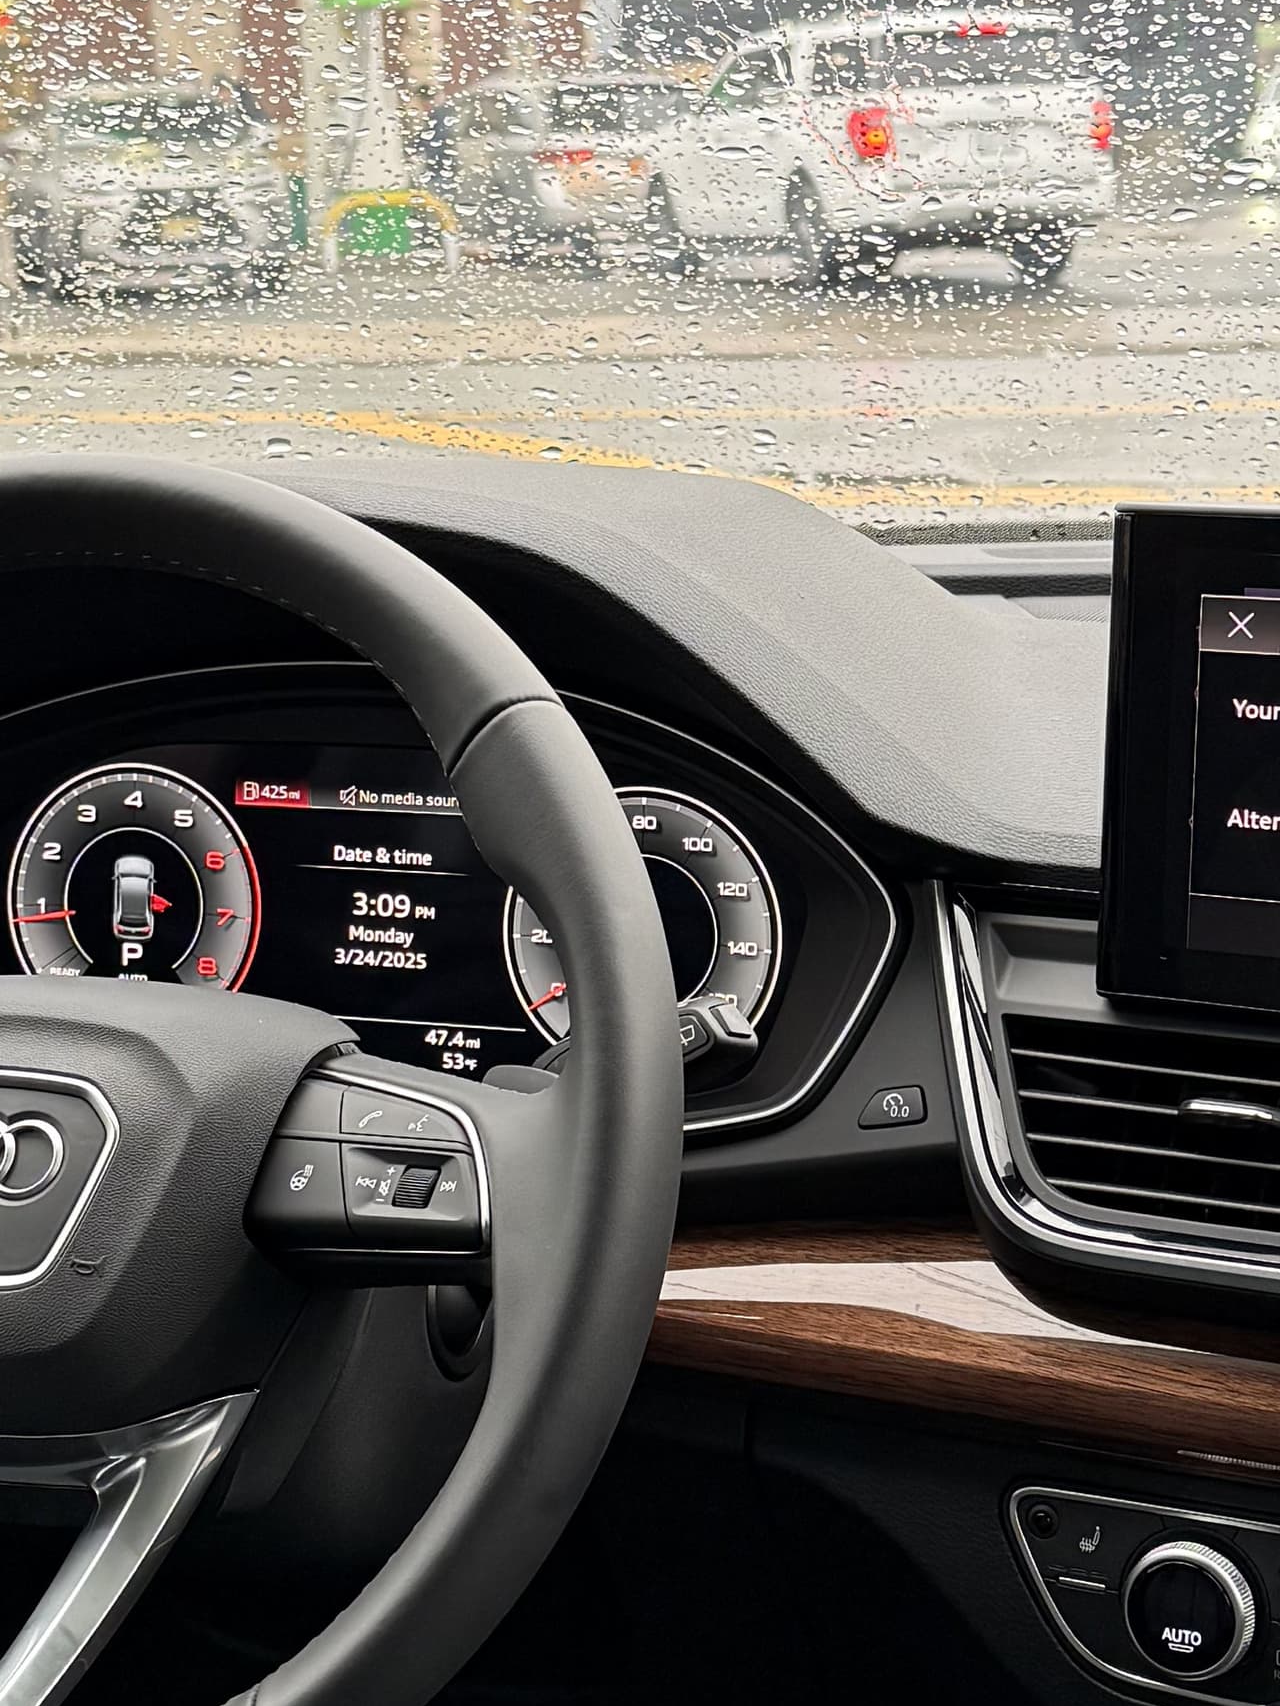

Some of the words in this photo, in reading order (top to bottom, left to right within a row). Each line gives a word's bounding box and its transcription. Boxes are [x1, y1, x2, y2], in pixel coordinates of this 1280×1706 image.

[124, 791, 144, 808] 4
[359, 790, 378, 803] No
[382, 792, 423, 806] media
[426, 794, 460, 808] sour
[77, 805, 97, 823] 3
[174, 809, 194, 827] 5
[632, 815, 657, 831] 80
[42, 842, 61, 860] 2
[682, 837, 713, 852] 100
[206, 851, 225, 870] 6
[333, 845, 372, 863] Date
[376, 848, 390, 864] &
[394, 849, 433, 866] time
[717, 882, 748, 897] 120
[36, 897, 47, 914] 1
[352, 892, 411, 918] 3:09
[415, 906, 436, 920] PM
[216, 908, 234, 926] 7
[348, 925, 414, 948] Monday
[121, 943, 144, 966] P
[727, 941, 758, 957] 140
[197, 957, 217, 976] 8
[334, 948, 428, 970] 3/24/2025
[50, 967, 81, 977] READY
[890, 1105, 910, 1118] 0.0
[1161, 1627, 1202, 1646] AUTO
